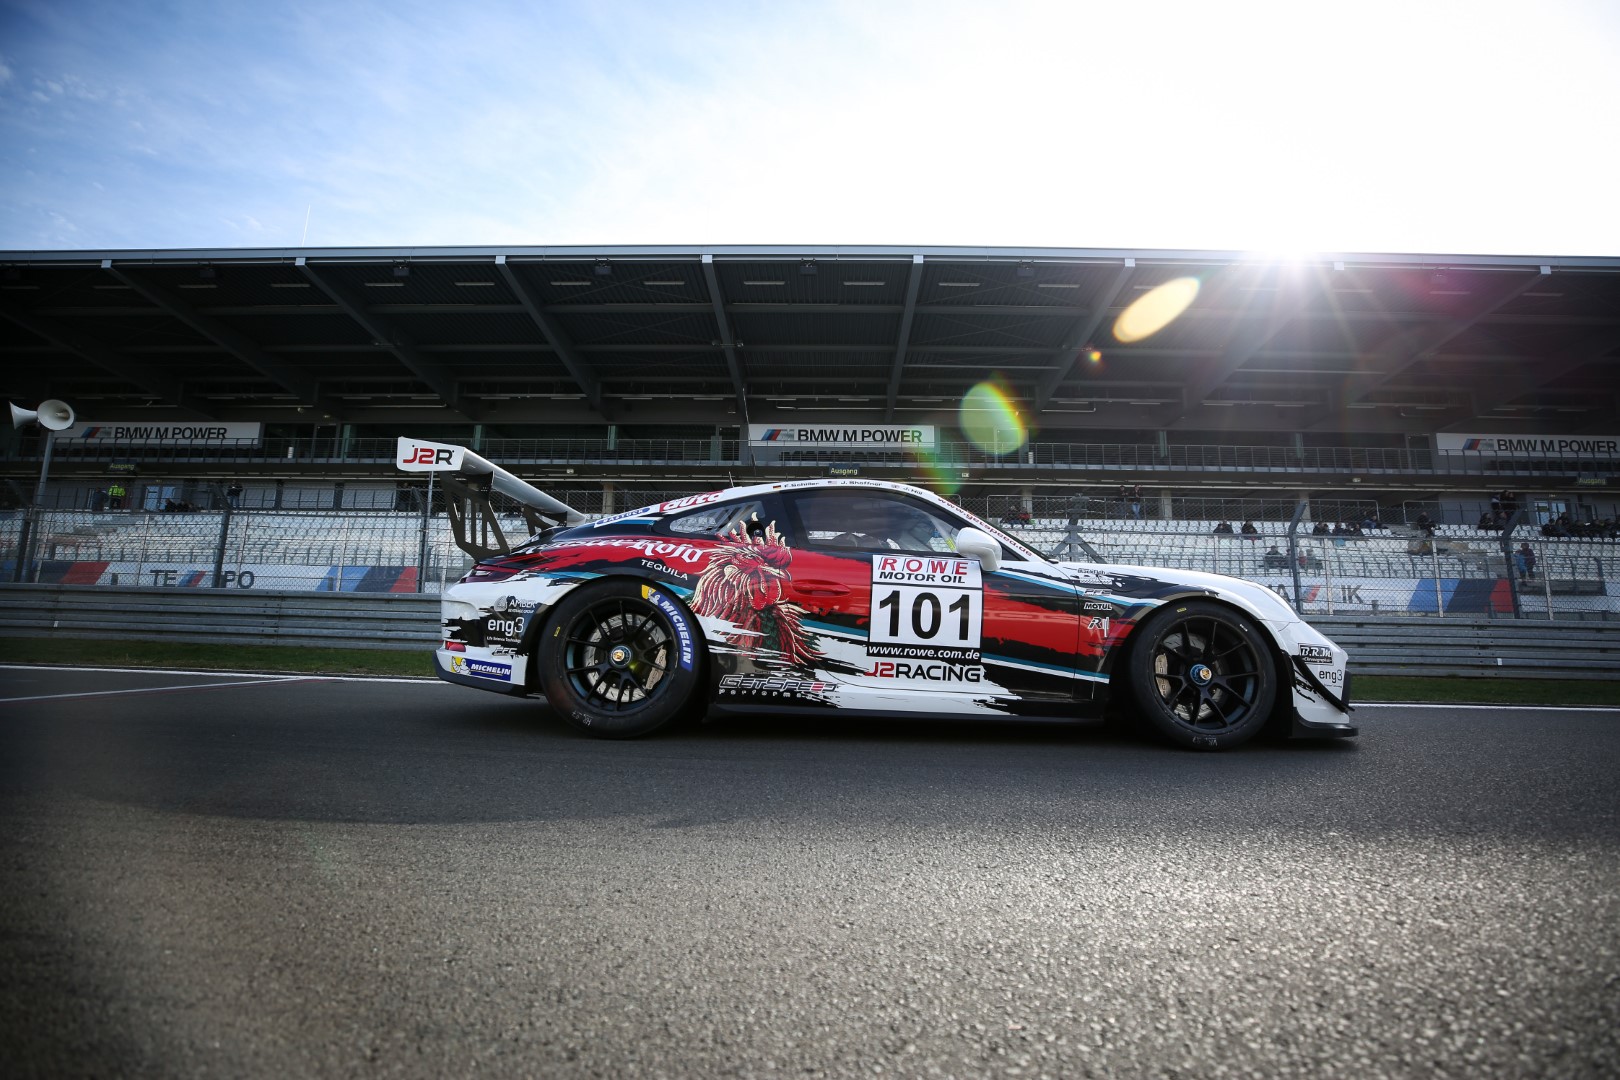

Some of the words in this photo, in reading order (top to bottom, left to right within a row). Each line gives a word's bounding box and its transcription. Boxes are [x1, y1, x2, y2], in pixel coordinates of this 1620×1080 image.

[115, 427, 153, 438] BMW
[155, 427, 169, 438] M
[172, 427, 227, 439] POWER
[798, 429, 840, 442] BMW
[843, 430, 857, 442] M
[862, 430, 922, 442] POWER
[1497, 439, 1537, 452] BMW
[1541, 439, 1555, 452] M
[1558, 440, 1617, 453] POWER
[403, 447, 453, 465] J2R
[830, 467, 858, 475] Ausgang
[641, 559, 689, 581] TEQUILA
[879, 557, 969, 575] ROWE
[879, 571, 936, 582] MOTOR
[941, 575, 966, 584] OIL
[1084, 602, 1112, 610] MOTUL
[879, 590, 970, 641] 101
[487, 616, 525, 637] eng3
[660, 600, 692, 664] MICHELIN
[868, 646, 980, 660] www.rowe.com.de
[471, 664, 511, 675] MICHELIN
[864, 662, 981, 682] J2RACING
[1319, 669, 1343, 684] eng3
